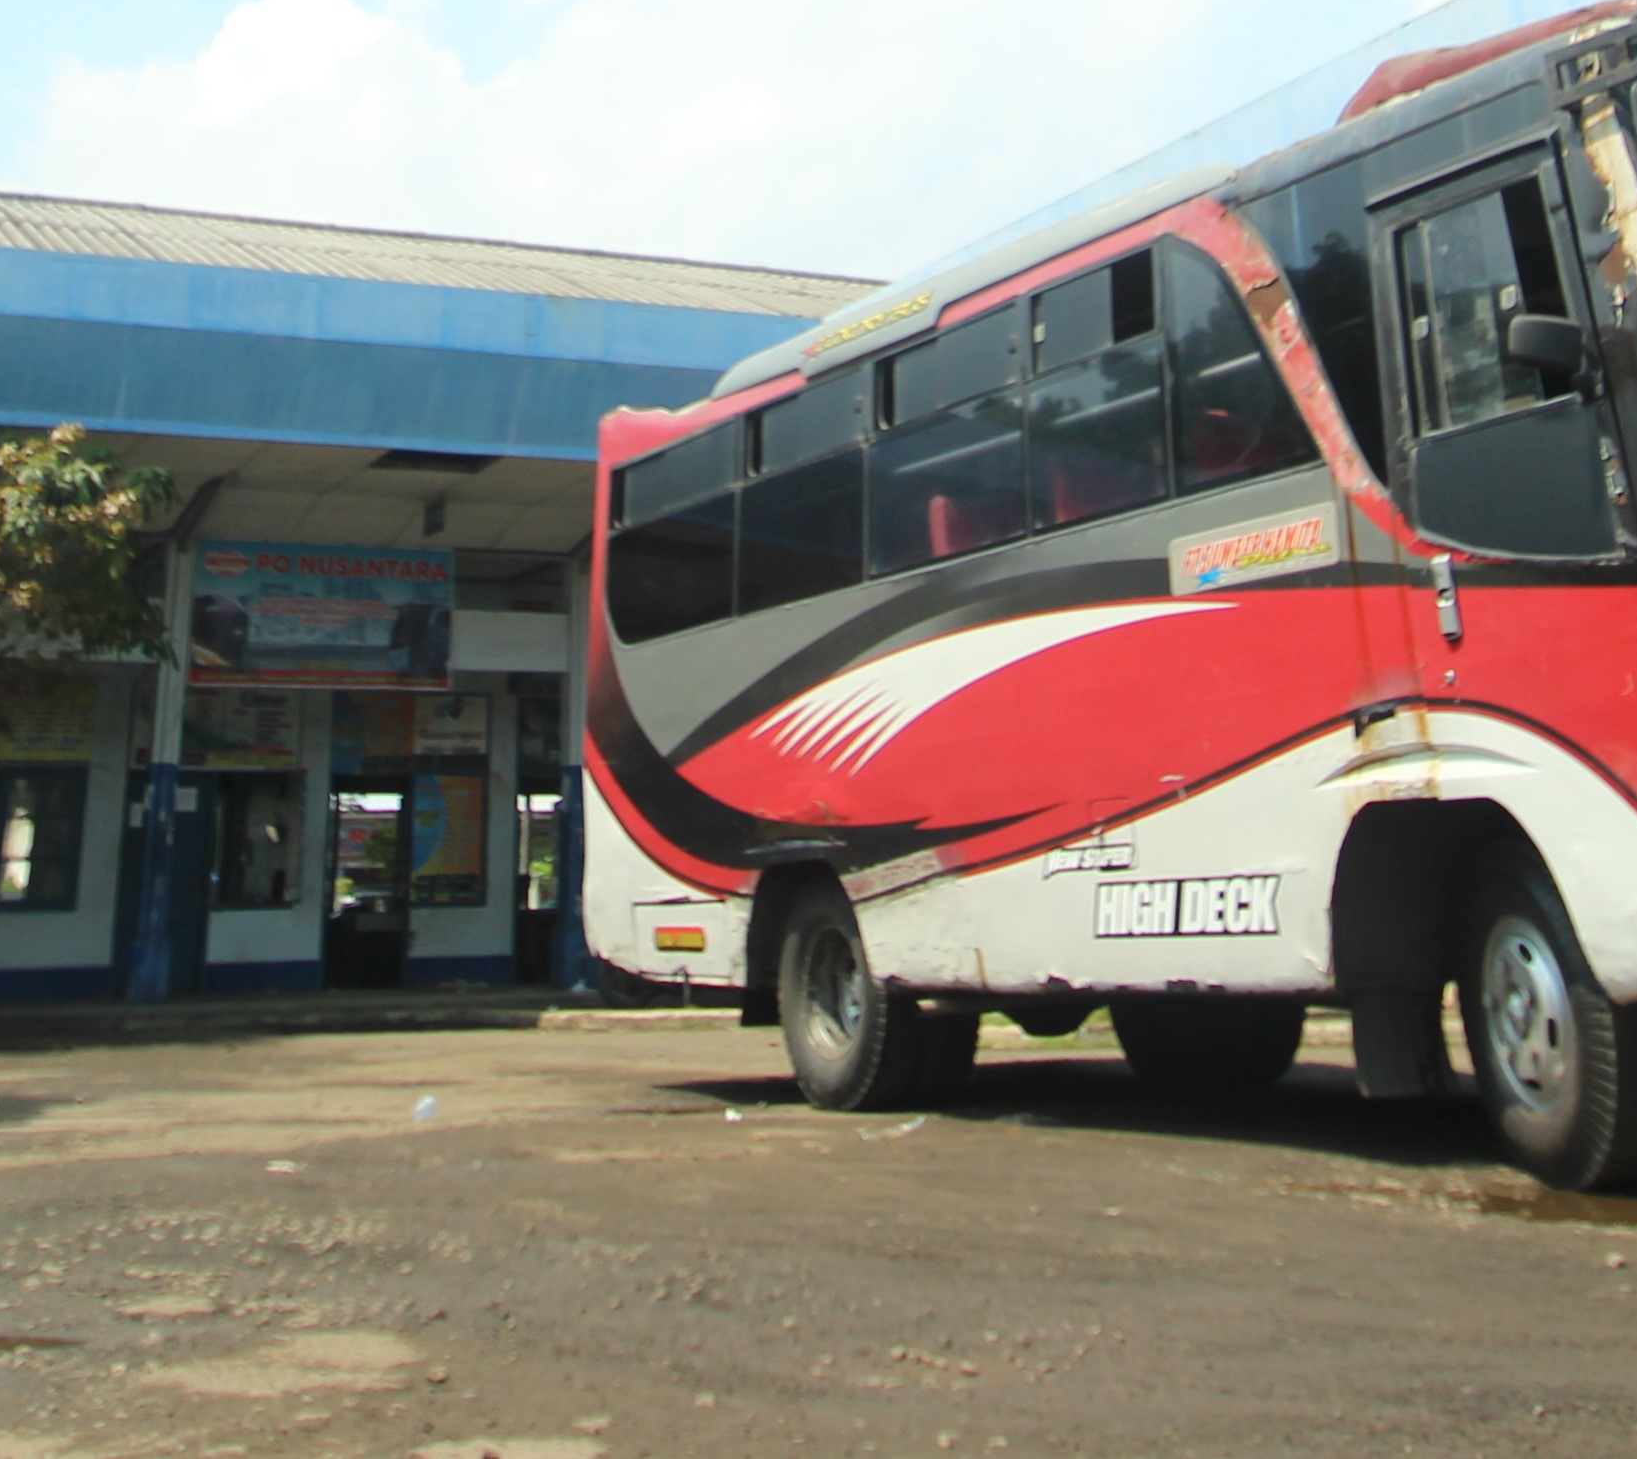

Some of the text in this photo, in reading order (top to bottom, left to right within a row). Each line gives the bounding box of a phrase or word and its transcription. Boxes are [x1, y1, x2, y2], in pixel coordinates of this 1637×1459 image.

[256, 553, 292, 574] PO
[298, 555, 449, 582] NUSANTARA
[1097, 875, 1281, 936] HIGH DECK
